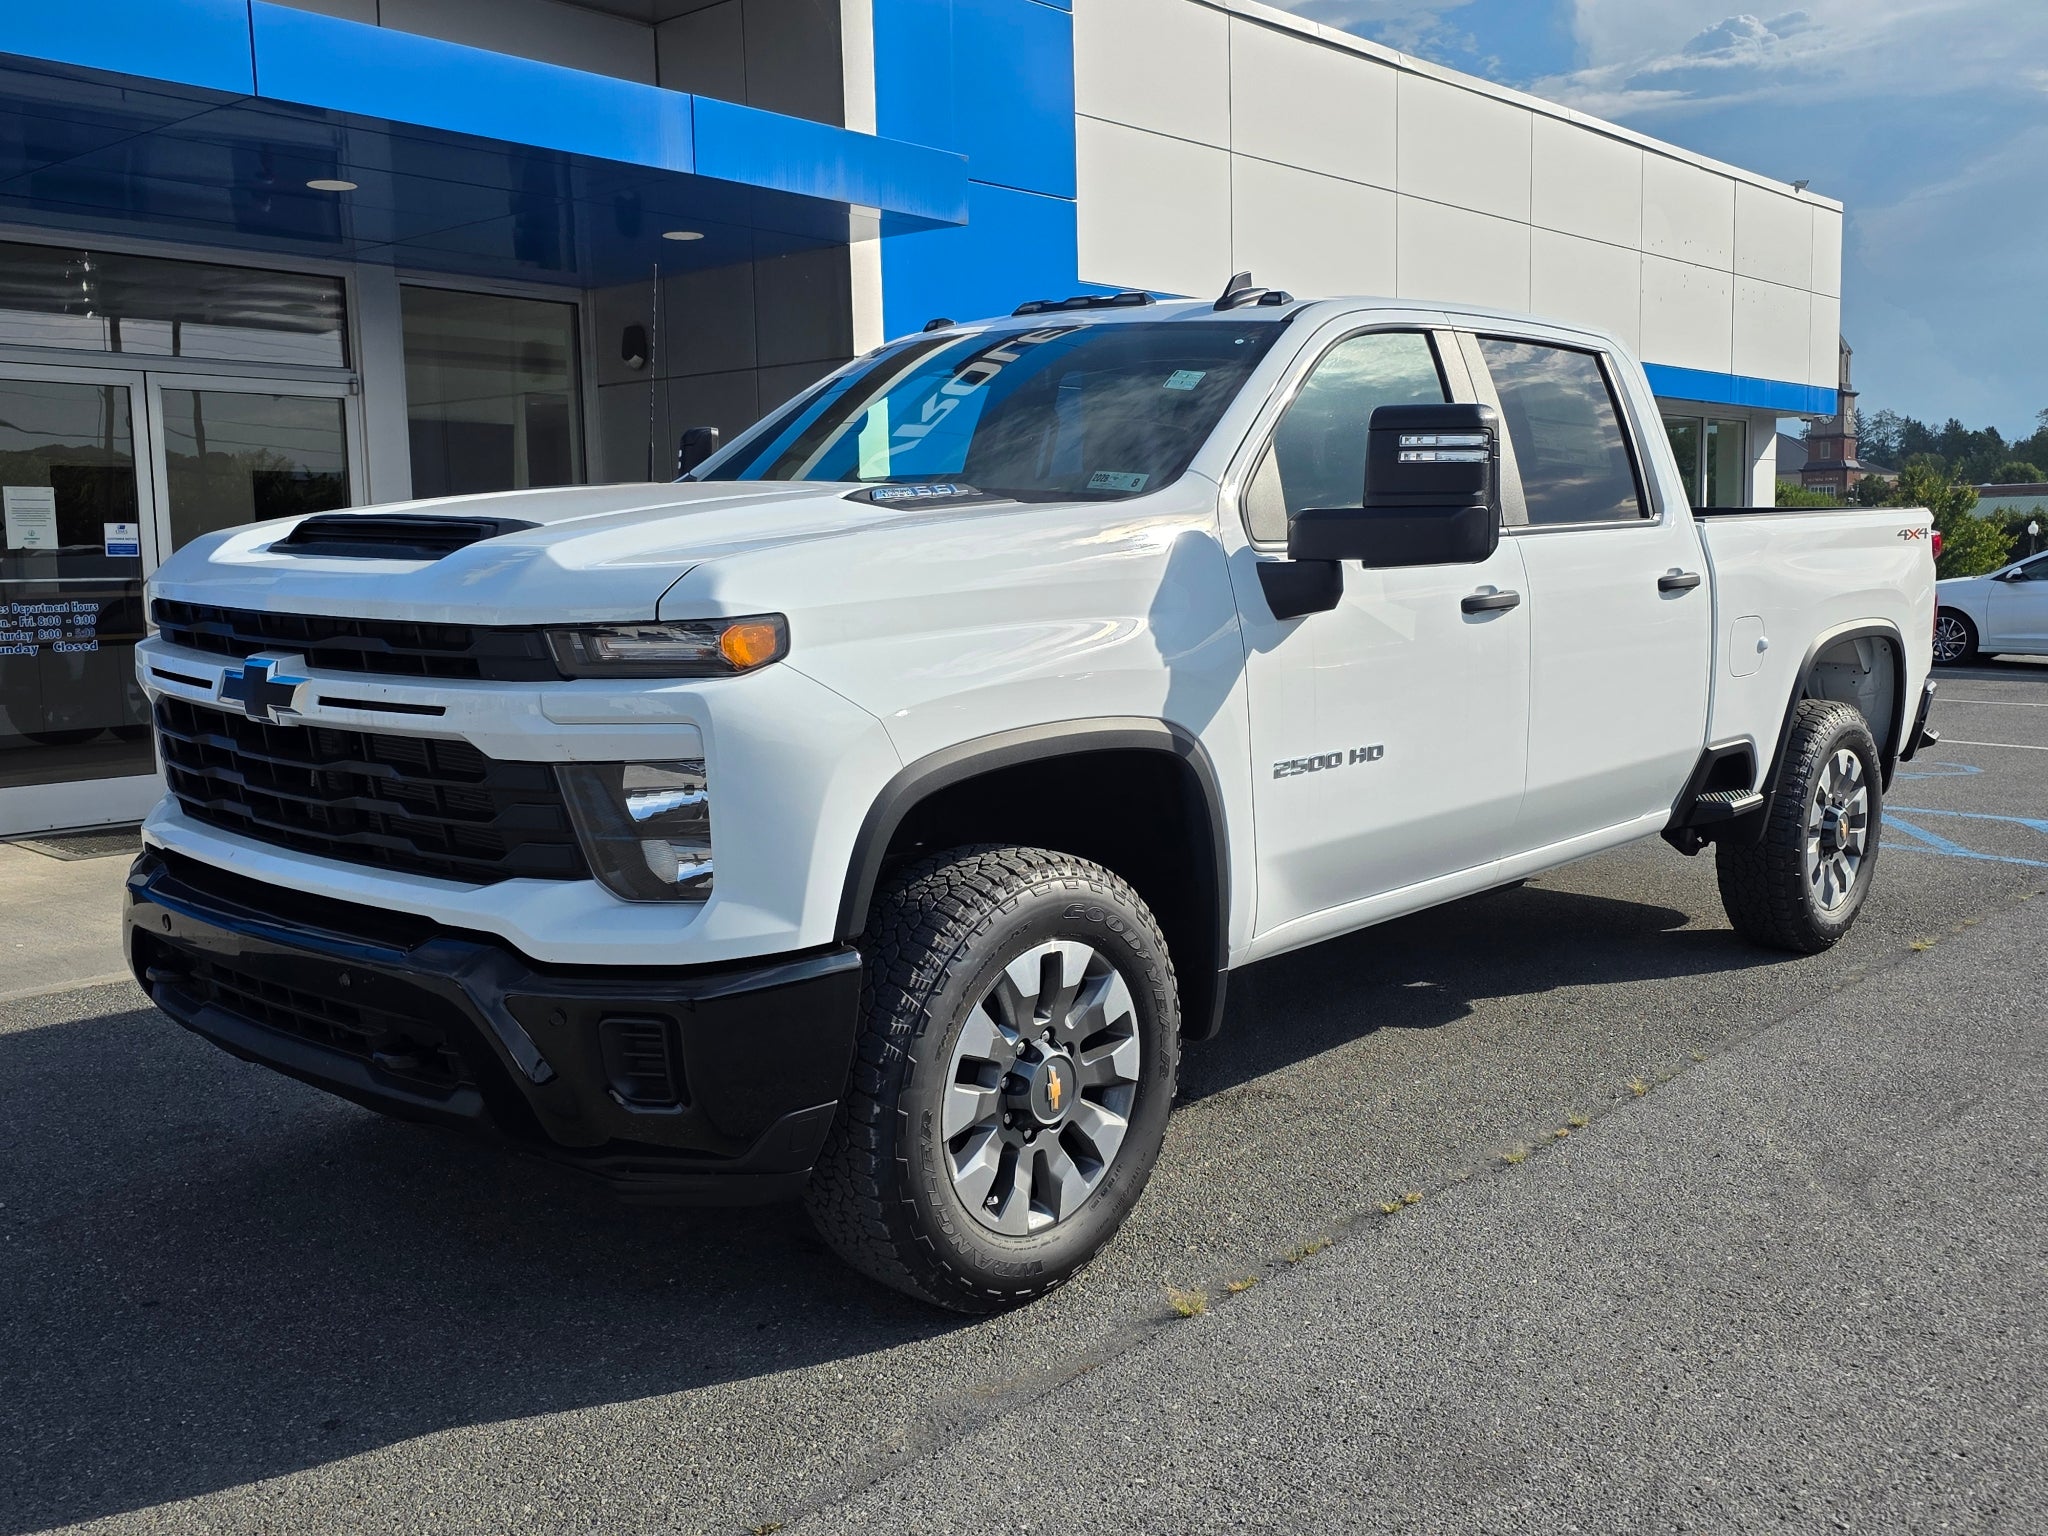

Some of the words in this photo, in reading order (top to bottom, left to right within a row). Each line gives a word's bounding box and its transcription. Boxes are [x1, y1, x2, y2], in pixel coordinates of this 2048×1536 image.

[1131, 478, 1140, 488] 8
[12, 603, 69, 616] Department
[71, 601, 98, 612] Hours
[19, 615, 36, 627] Fri.
[38, 615, 61, 626] 8:00
[73, 614, 96, 625] 6:00
[38, 629, 62, 640] 8:00
[53, 640, 98, 652] Closed
[1273, 751, 1342, 779] 2500
[1349, 744, 1384, 765] HD
[920, 1108, 1046, 1278] WRANGLER
